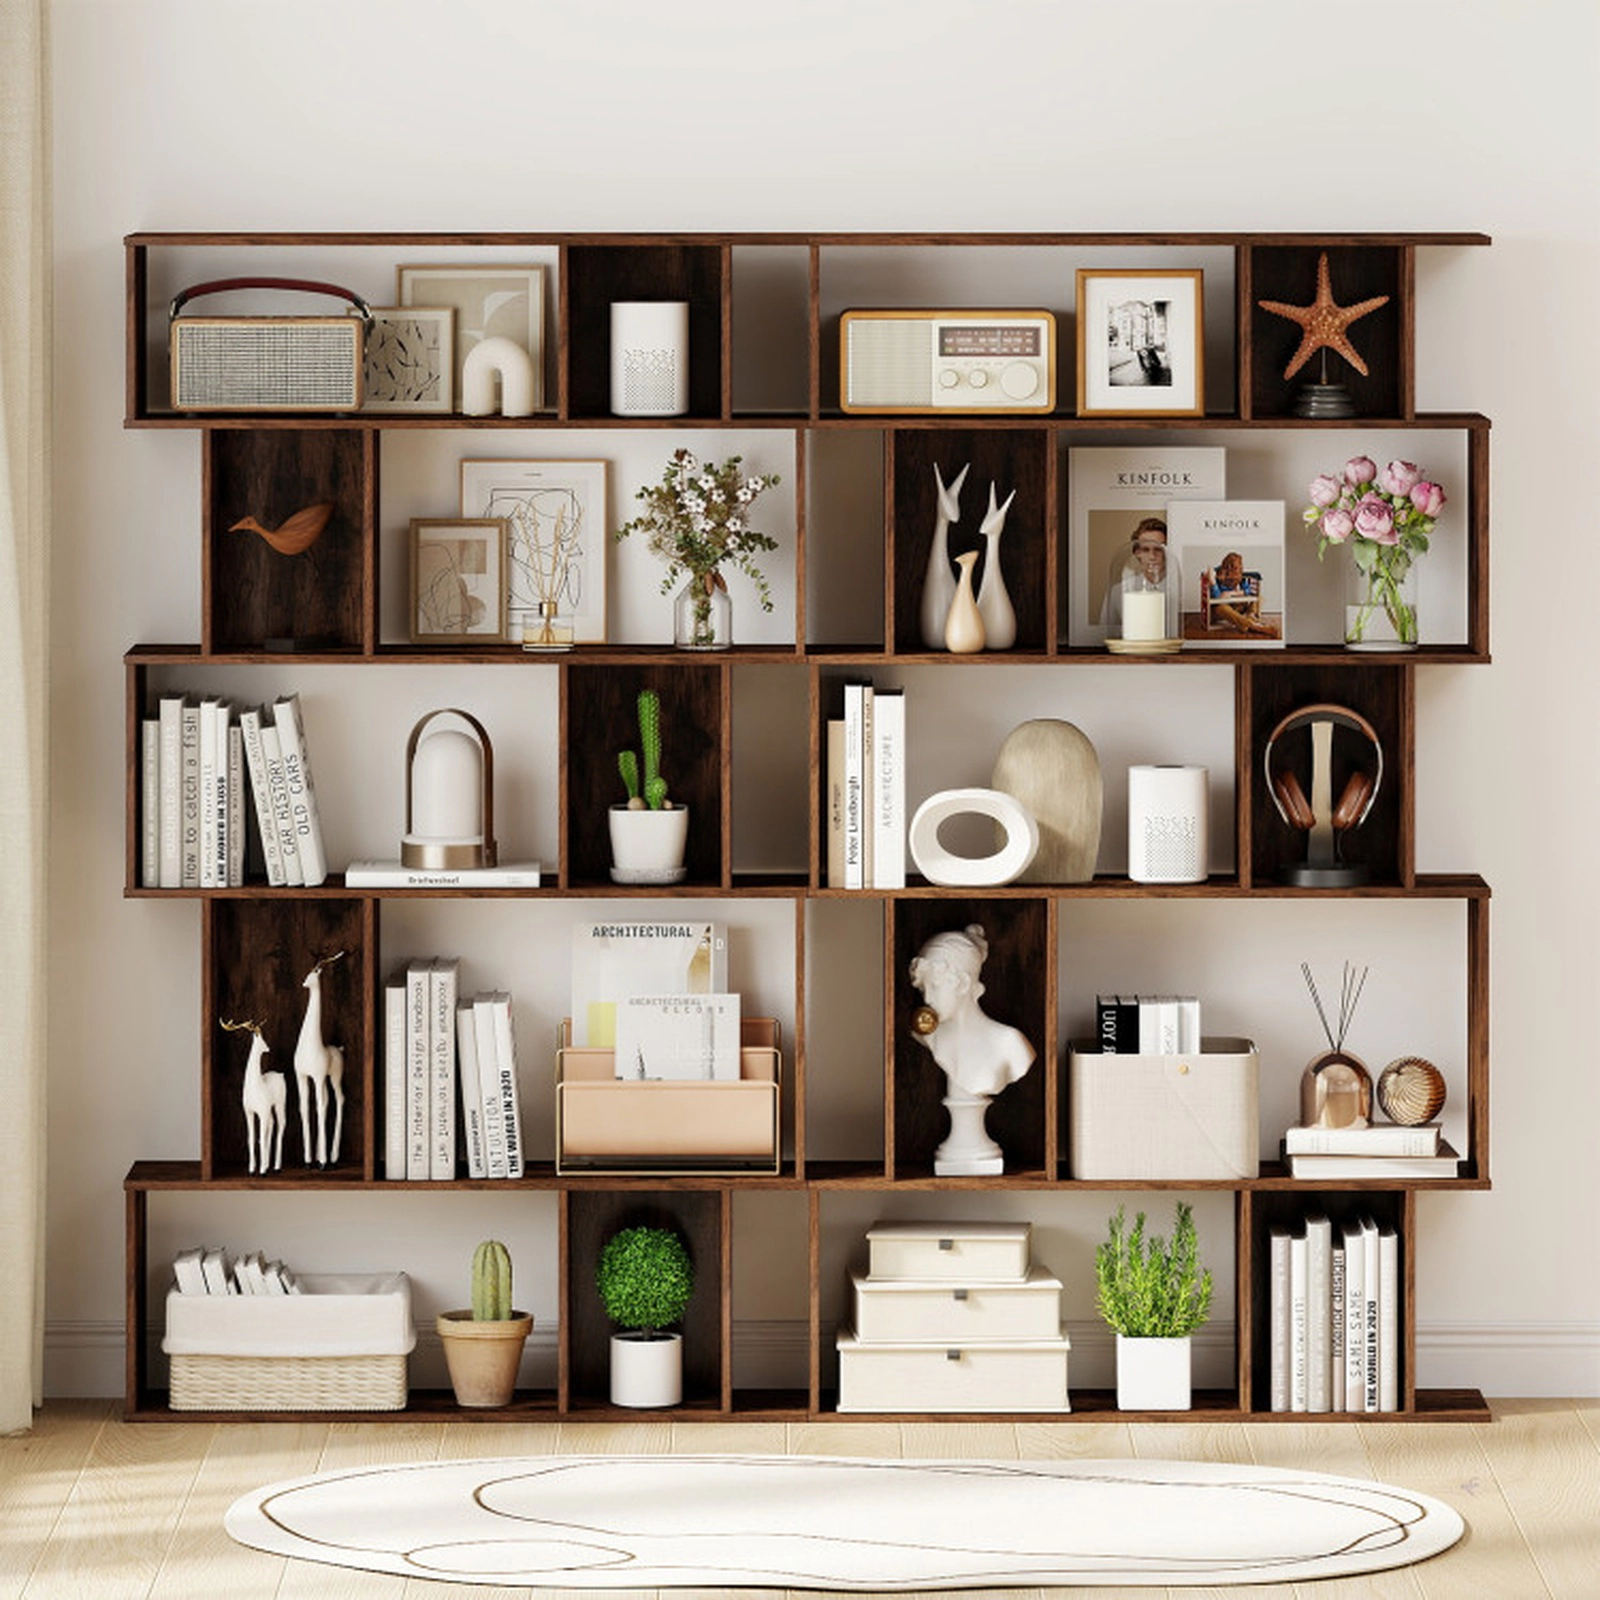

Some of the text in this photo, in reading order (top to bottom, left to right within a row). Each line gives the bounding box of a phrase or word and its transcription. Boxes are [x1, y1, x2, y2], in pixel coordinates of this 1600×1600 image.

[1117, 472, 1193, 485] KINFOLK
[1204, 520, 1261, 529] KINFOLK
[184, 716, 197, 880] How to catch a fish
[286, 753, 310, 835] OLD CARS
[882, 734, 893, 828] ARCHITECTURE
[269, 758, 296, 856] CAR HISTORY
[847, 776, 860, 865] Peter Lindbergh
[592, 925, 693, 938] ARCHITECTURAL
[413, 1086, 423, 1136] Interior
[503, 1100, 514, 1112] IN
[485, 1096, 505, 1175] INTUITION
[505, 1114, 518, 1152] WORLD
[507, 1155, 519, 1174] THE
[1367, 1300, 1377, 1330] 2020
[1350, 1290, 1362, 1379] SAME SAME
[1367, 1332, 1377, 1343] IN
[1367, 1387, 1377, 1407] THE
